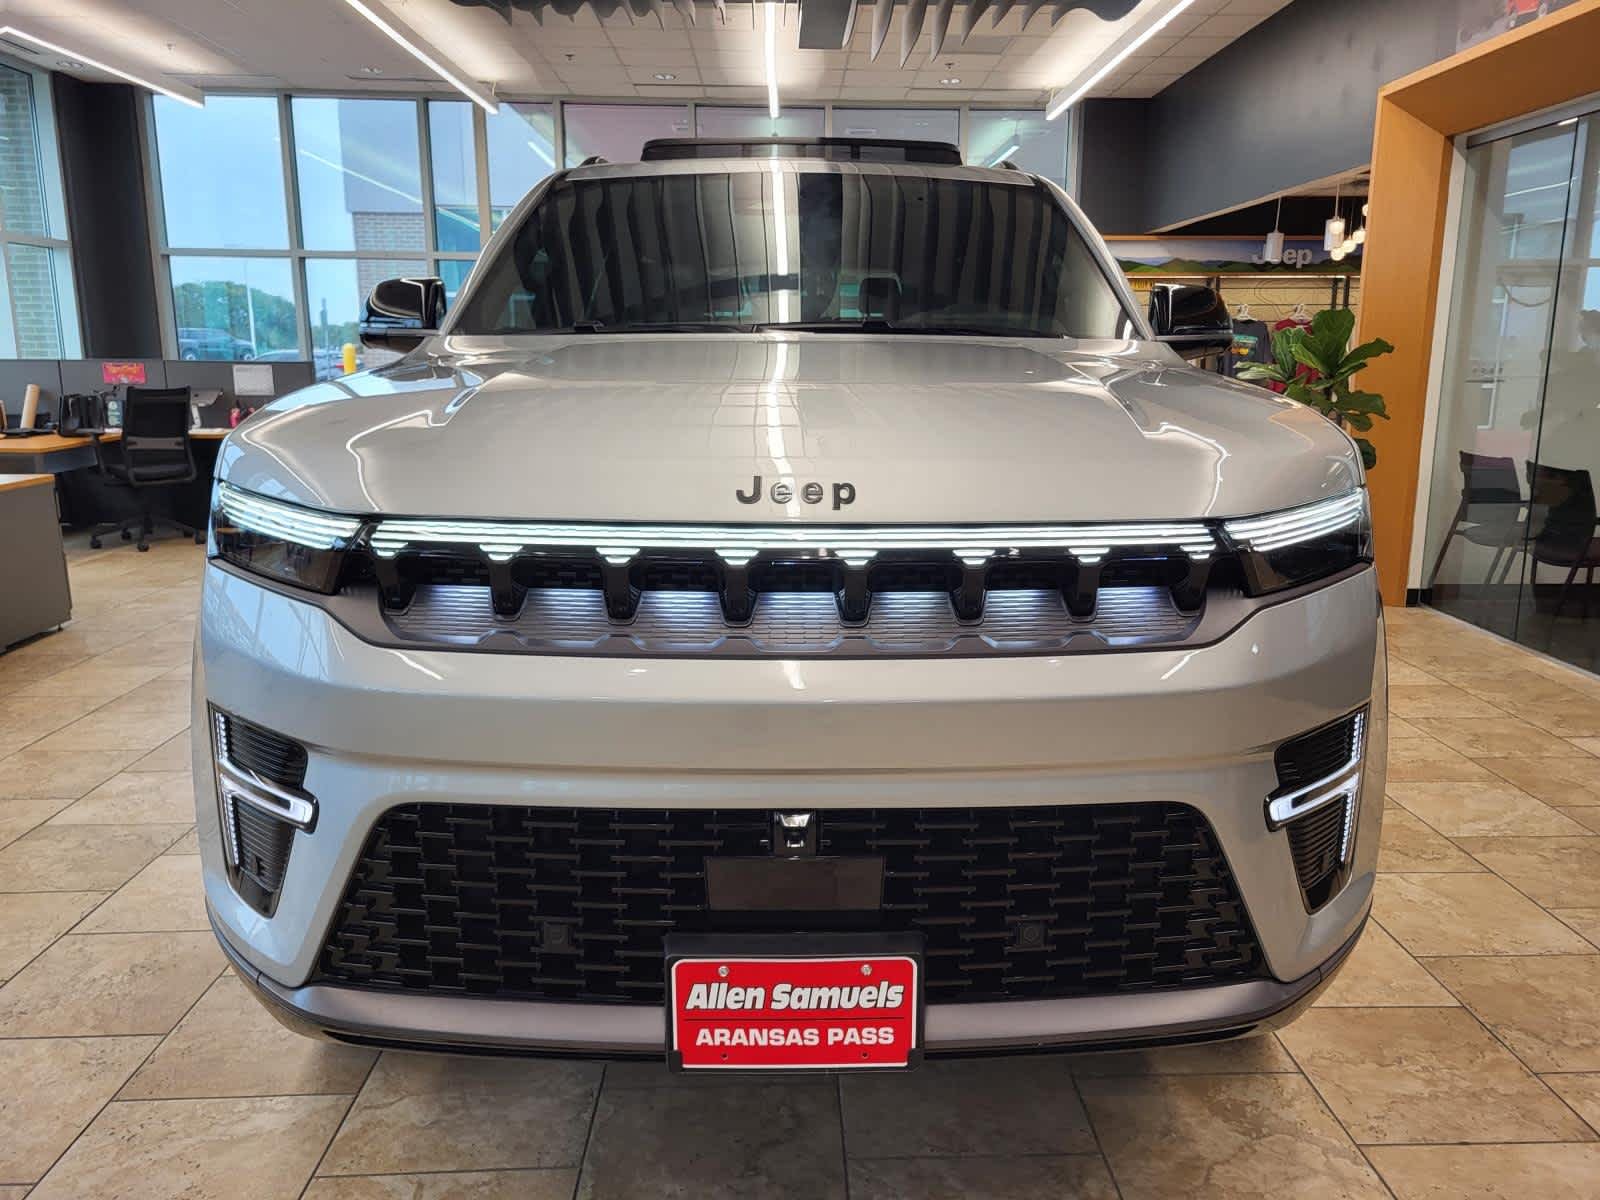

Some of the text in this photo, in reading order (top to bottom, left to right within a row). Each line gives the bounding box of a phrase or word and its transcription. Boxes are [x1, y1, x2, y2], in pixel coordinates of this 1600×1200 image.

[1251, 244, 1313, 269] Jep
[736, 475, 856, 511] Jeep
[685, 981, 904, 1010] Allen Samuels
[695, 1027, 895, 1046] ARANSAS PASS
